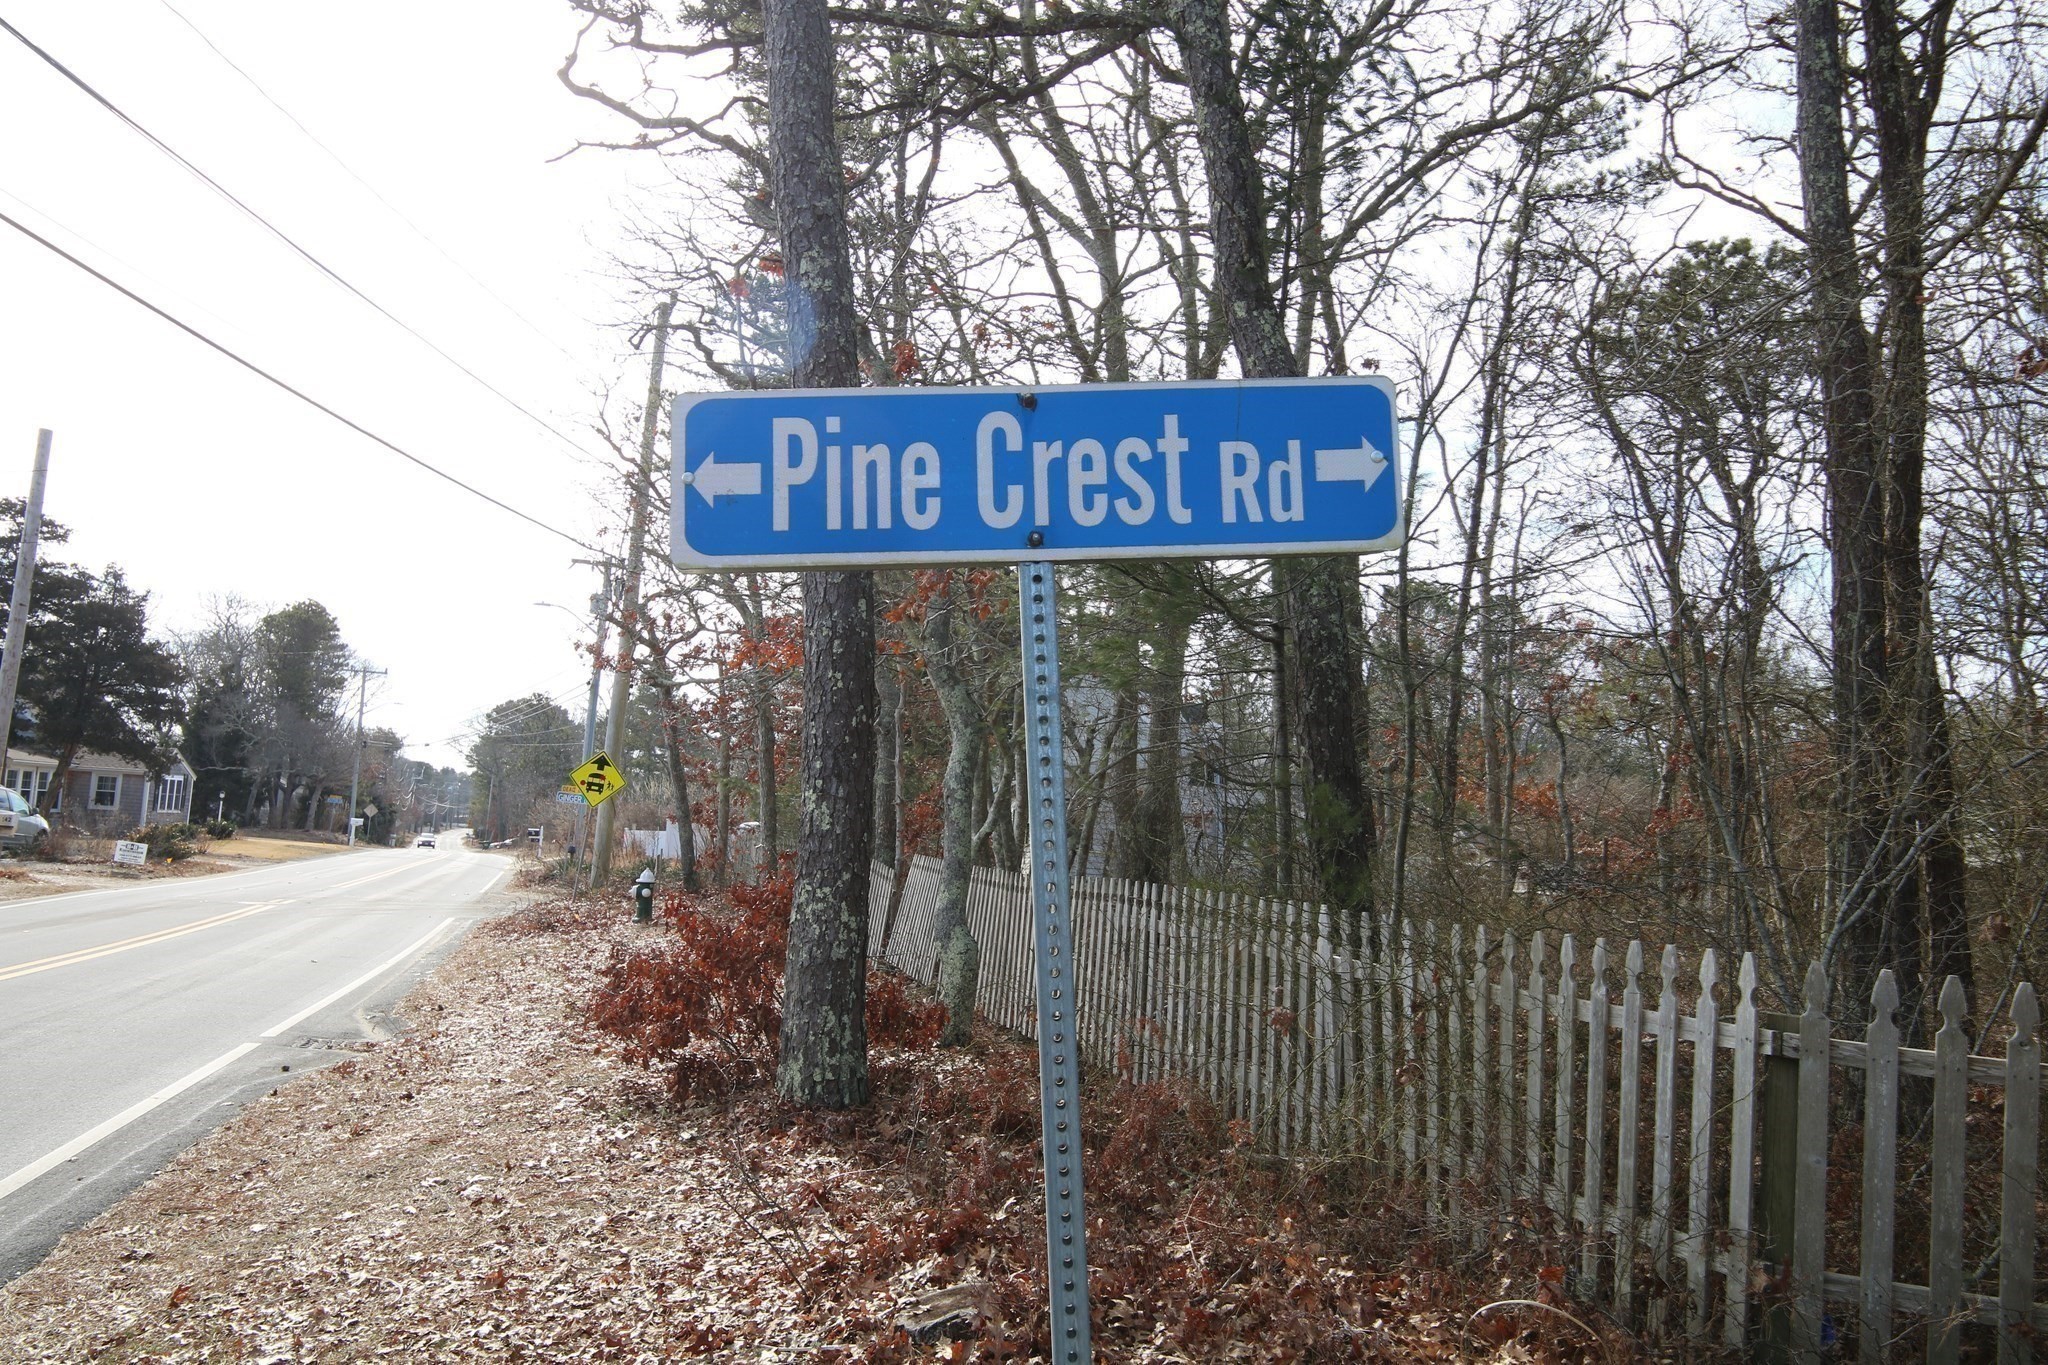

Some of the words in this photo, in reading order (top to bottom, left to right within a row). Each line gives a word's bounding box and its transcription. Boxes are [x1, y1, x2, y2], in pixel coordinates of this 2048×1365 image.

[772, 416, 941, 532] Pine
[976, 411, 1192, 529] Crest
[1219, 439, 1304, 523] Rd
[558, 793, 582, 803] GINGER
